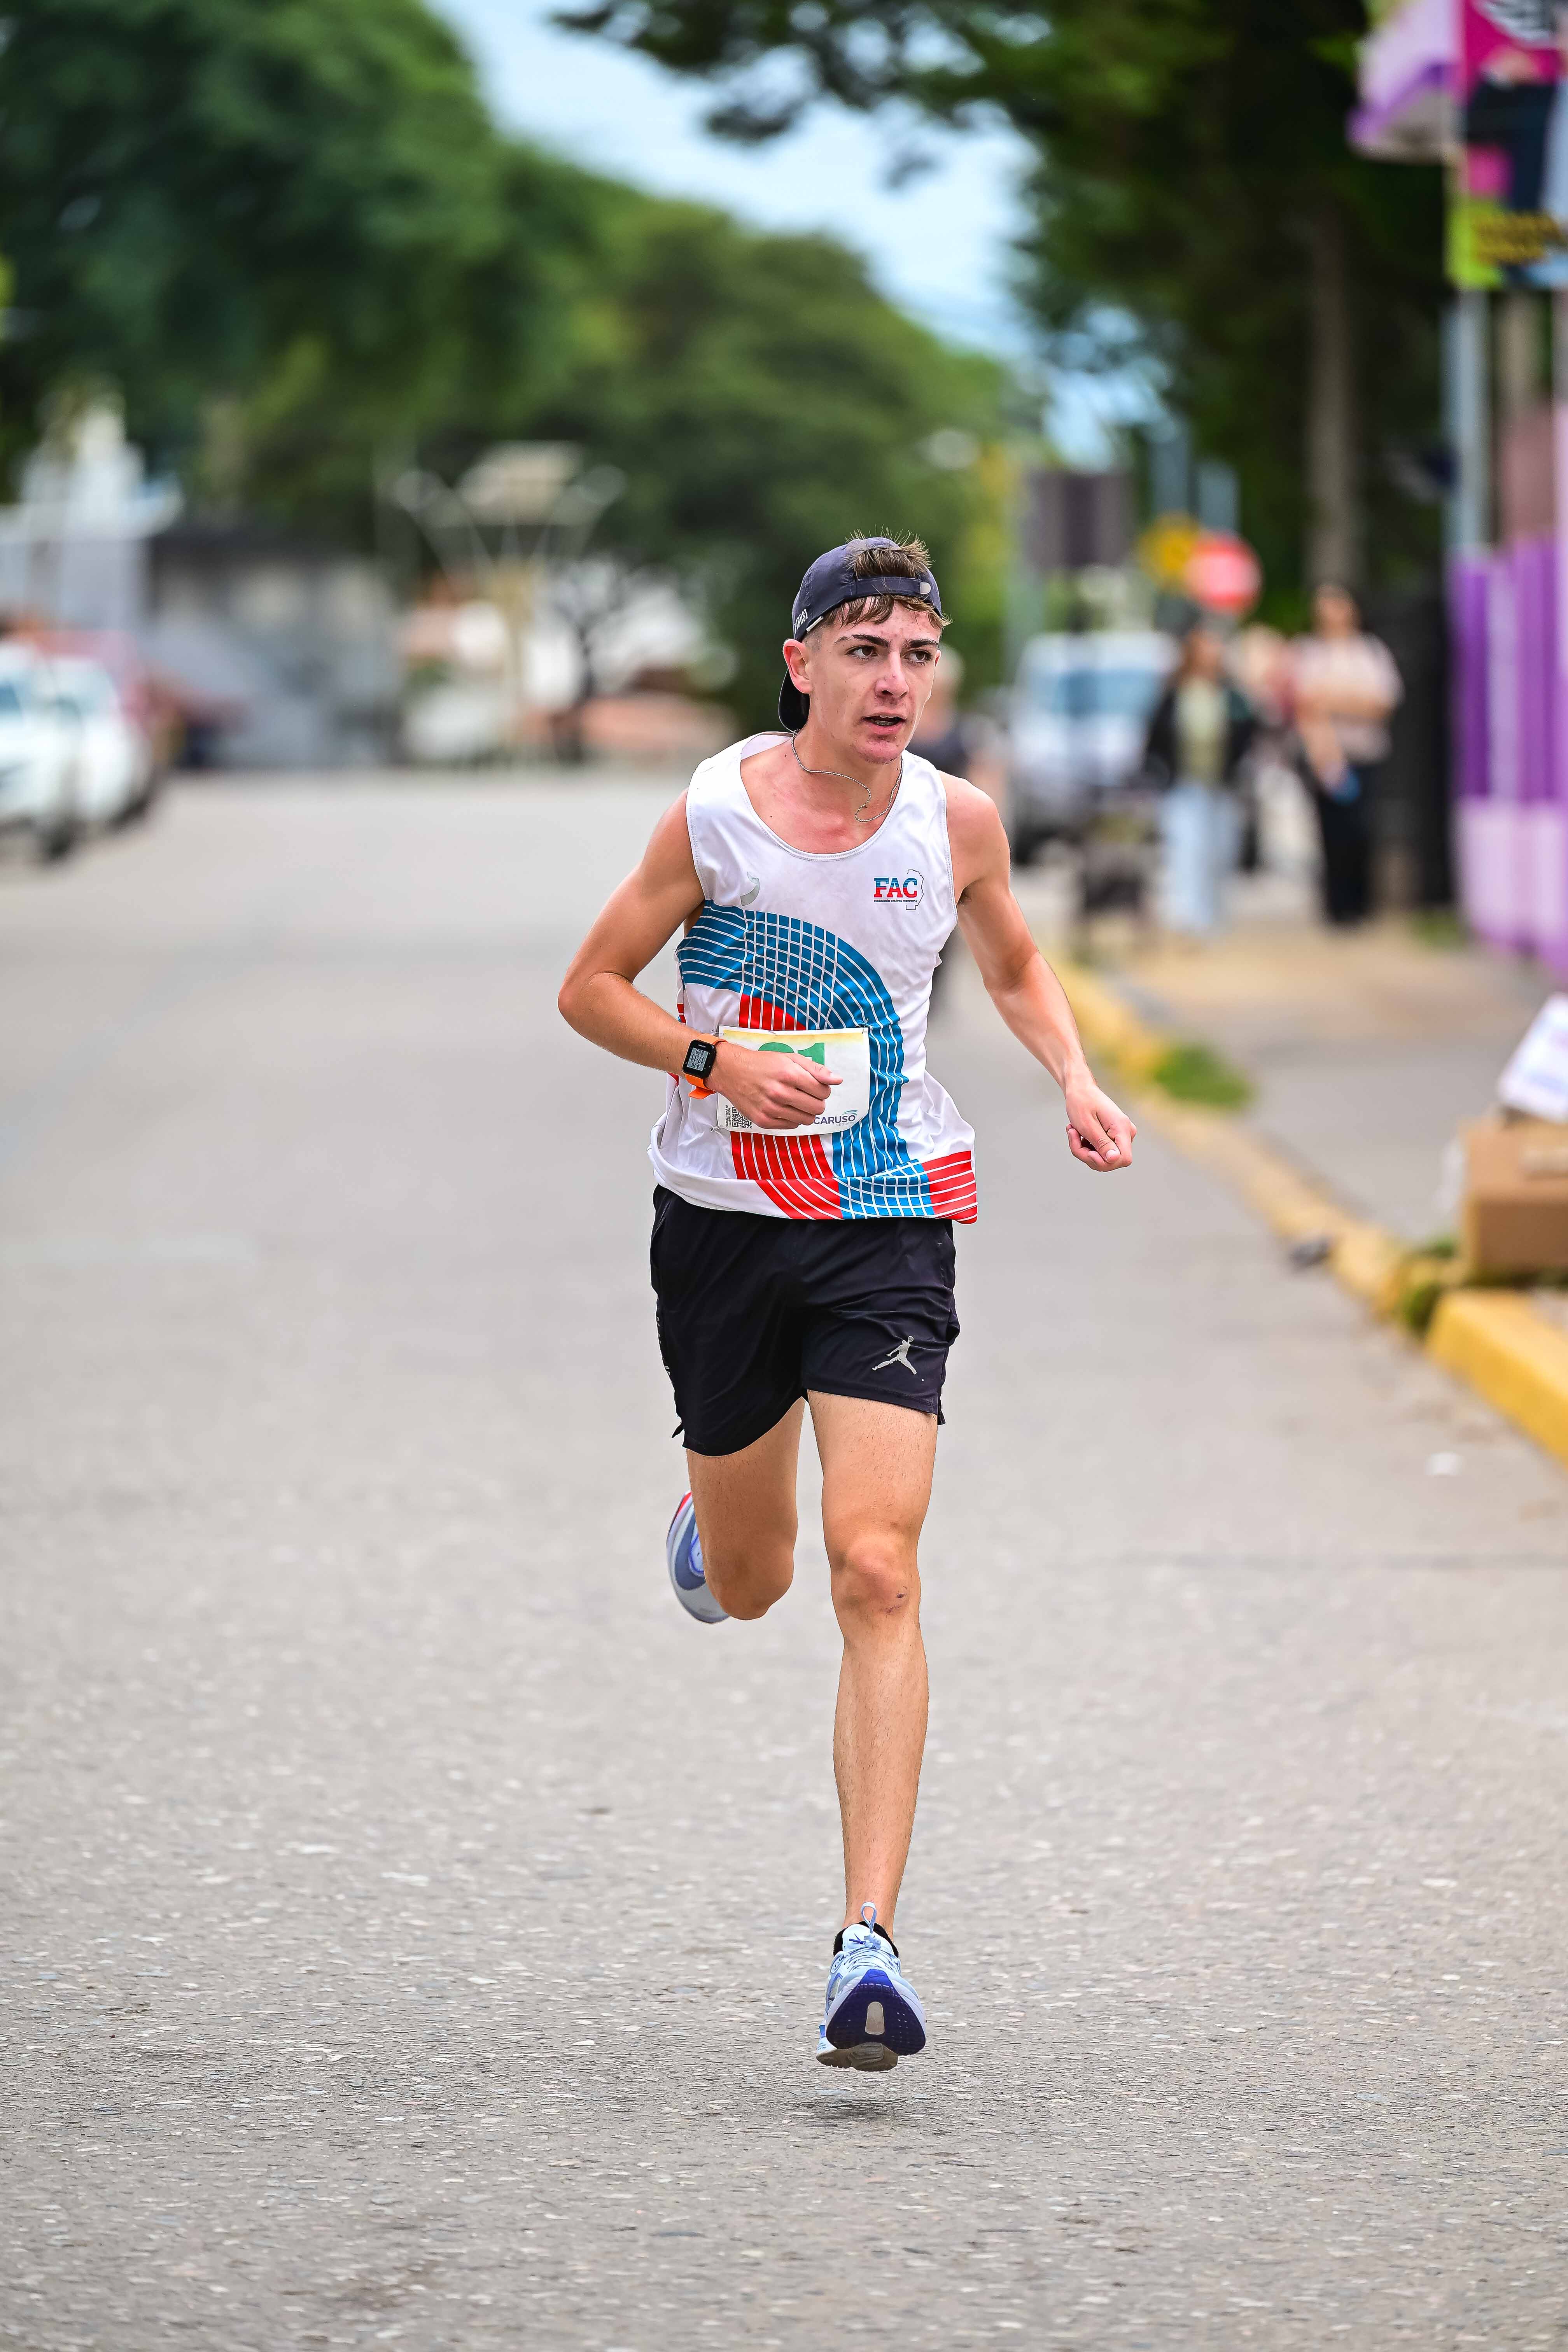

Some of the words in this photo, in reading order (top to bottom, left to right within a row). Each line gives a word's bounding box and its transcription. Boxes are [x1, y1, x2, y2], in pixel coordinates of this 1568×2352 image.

[874, 878, 917, 898] FAC
[691, 1054, 704, 1064] 17:11
[814, 1115, 856, 1124] CARUSO
